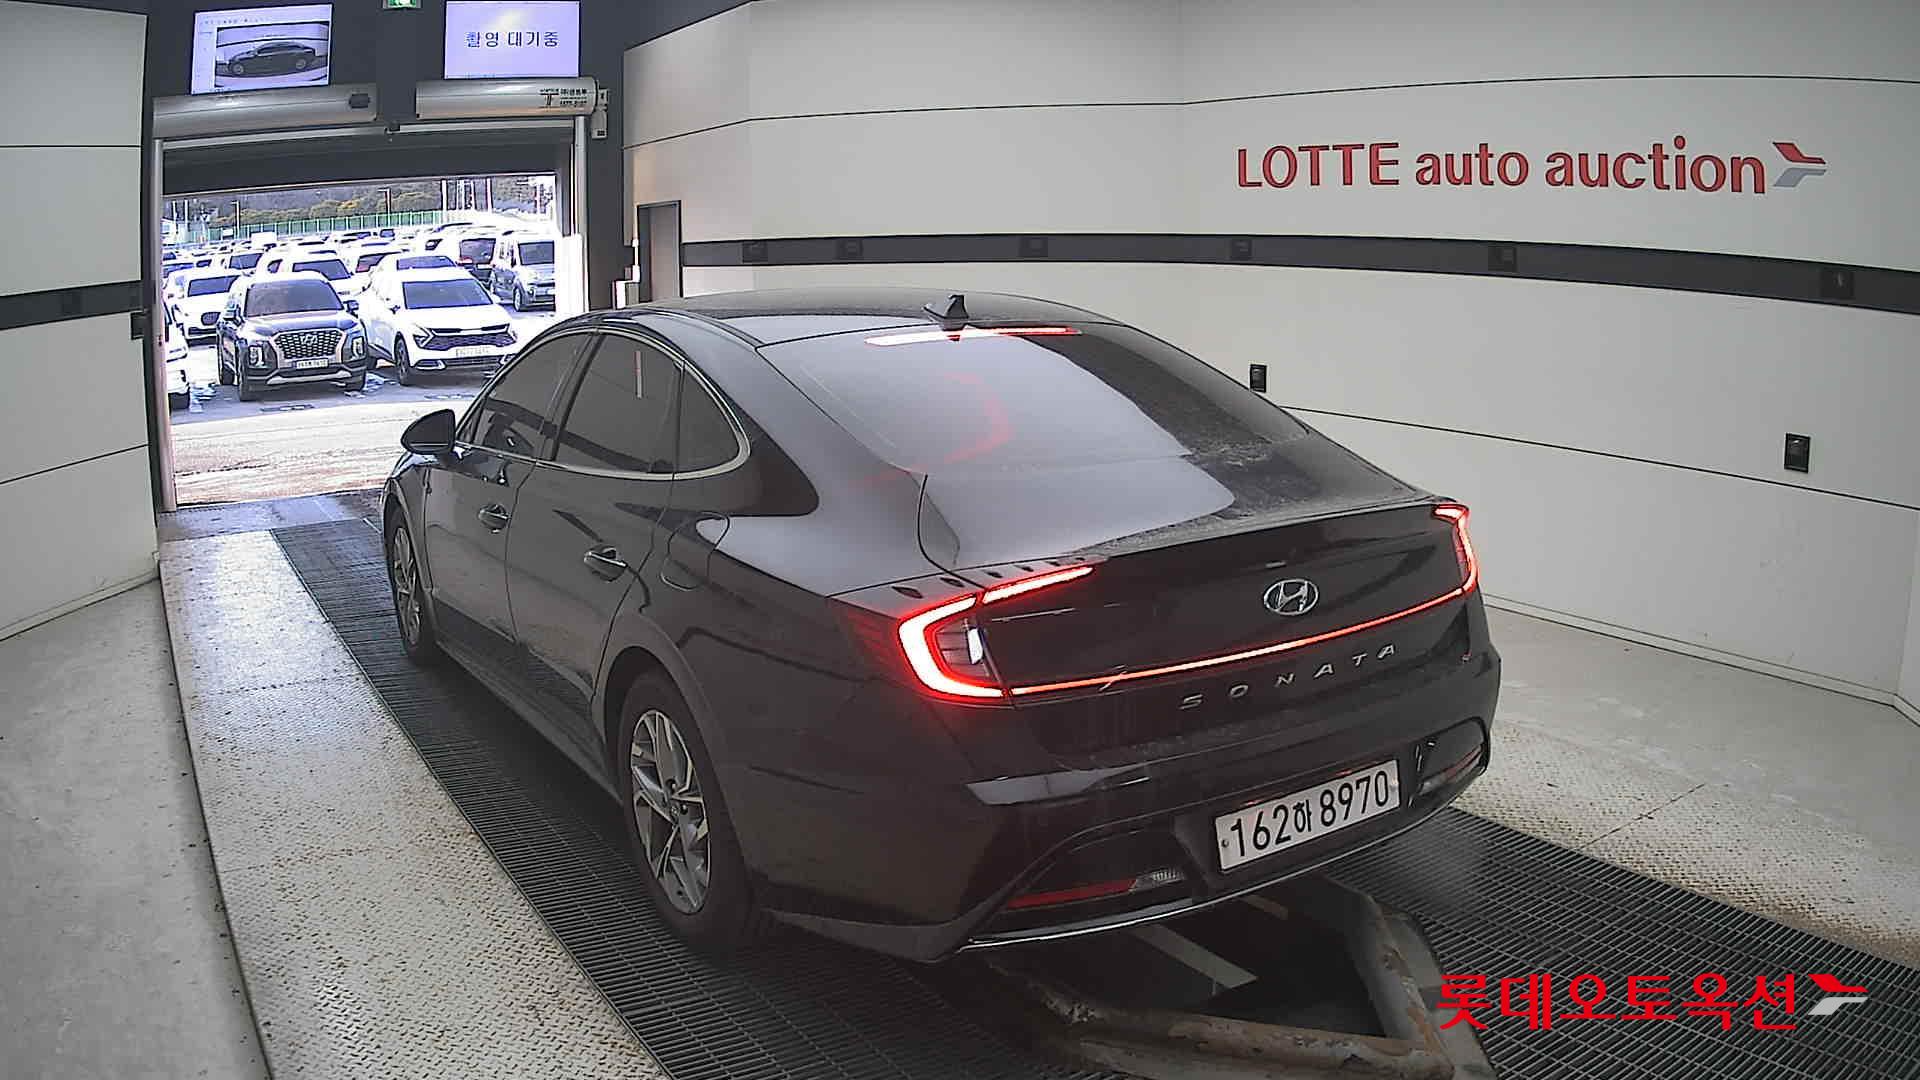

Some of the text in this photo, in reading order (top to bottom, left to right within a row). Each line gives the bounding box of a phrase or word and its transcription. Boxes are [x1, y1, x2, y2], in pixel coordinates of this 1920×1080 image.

[508, 31, 559, 47] 대기중
[1237, 136, 1767, 194] LOTTE auto auction
[1179, 643, 1397, 711] SONATA
[1230, 770, 1390, 857] 162하 8970
